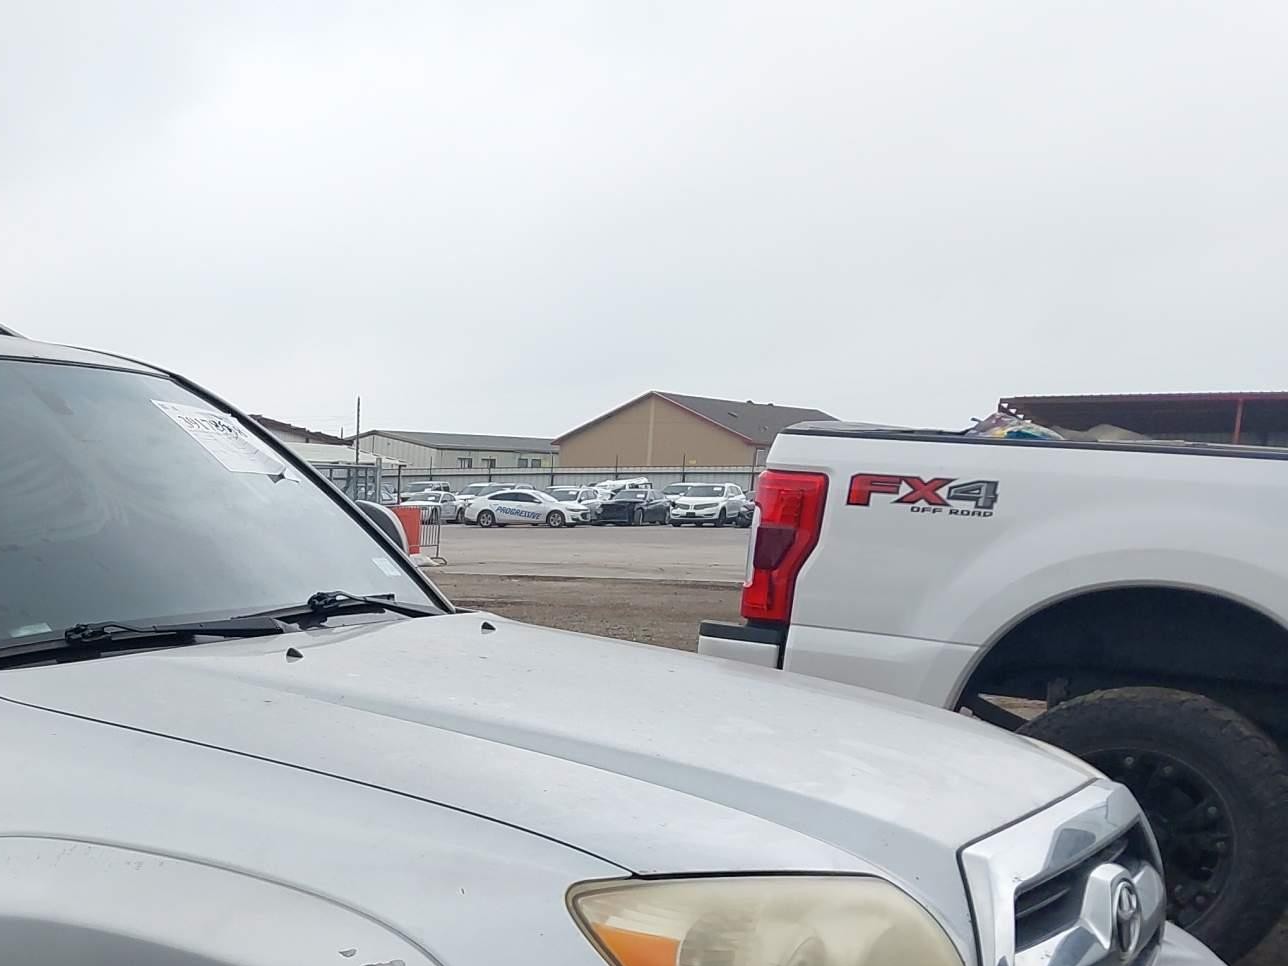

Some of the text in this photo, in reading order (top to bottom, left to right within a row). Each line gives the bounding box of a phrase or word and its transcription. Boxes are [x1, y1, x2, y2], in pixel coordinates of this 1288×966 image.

[845, 472, 999, 510] FX4
[495, 505, 542, 520] PROGRESSIVE
[910, 506, 993, 518] OFF ROAD
